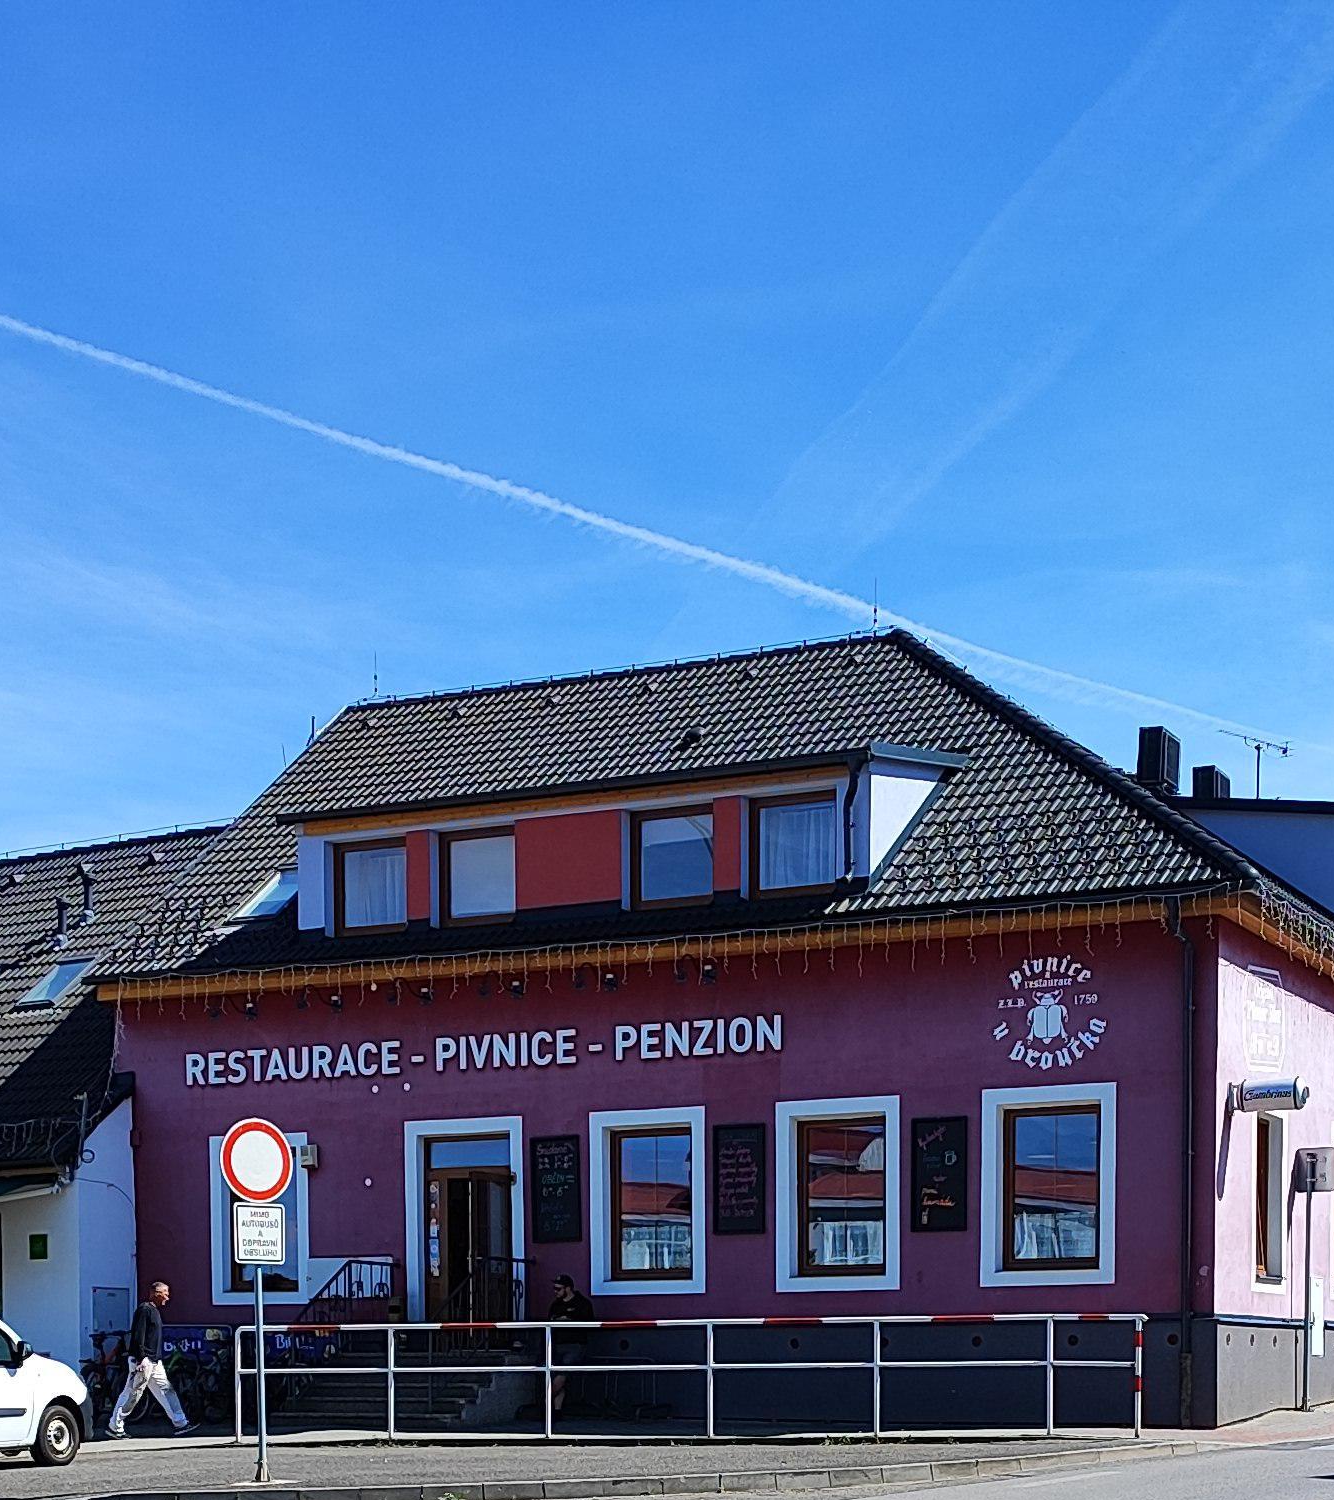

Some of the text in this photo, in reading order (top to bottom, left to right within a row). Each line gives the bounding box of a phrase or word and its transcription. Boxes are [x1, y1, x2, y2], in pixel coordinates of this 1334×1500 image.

[1074, 993, 1098, 1005] 1759
[185, 1040, 401, 1086] RESTAURACE
[435, 1028, 577, 1072] PIVNICE
[615, 1014, 782, 1061] PENZION
